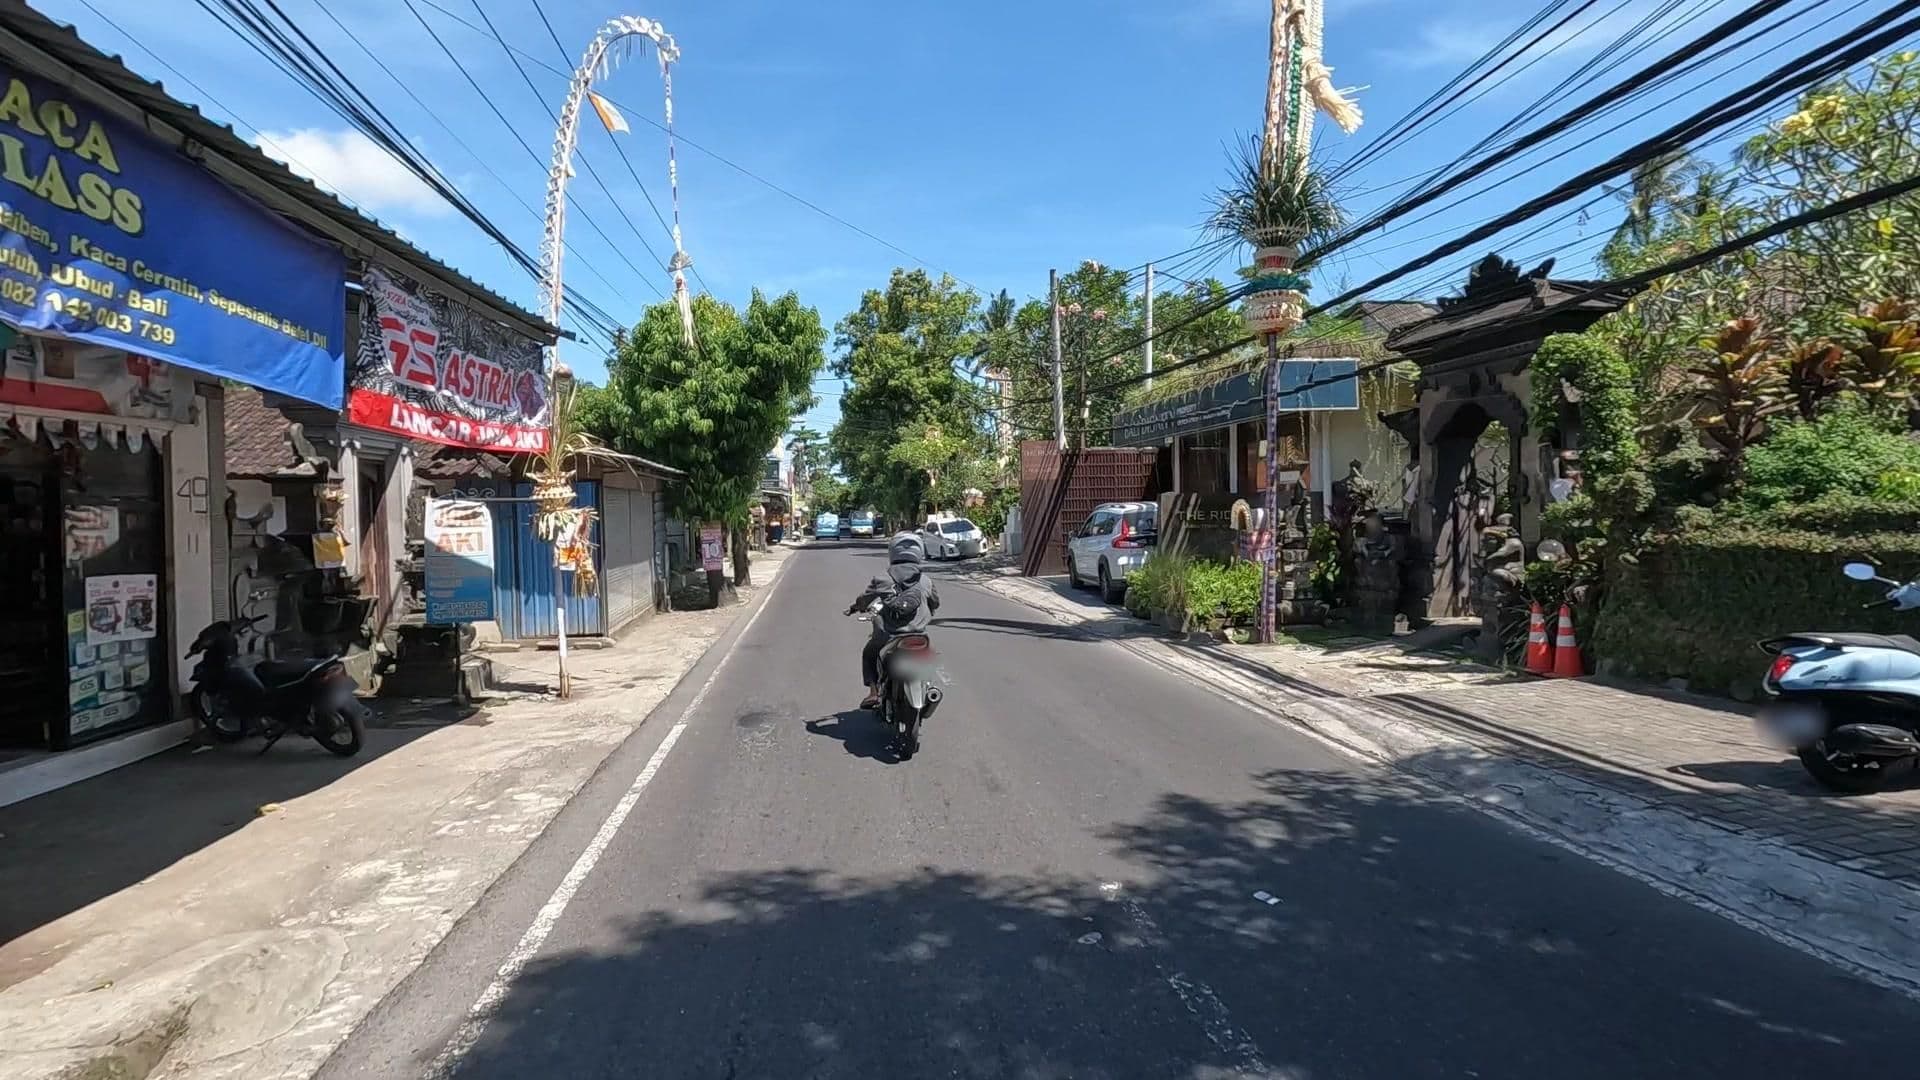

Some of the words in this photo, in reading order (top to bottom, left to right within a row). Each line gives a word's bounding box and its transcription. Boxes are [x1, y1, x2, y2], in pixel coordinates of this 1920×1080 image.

[0, 133, 143, 235] LASS
[51, 263, 114, 300] Ubud
[128, 289, 169, 317] Bali
[70, 234, 127, 272] Kaca
[132, 260, 204, 304] Cermin,
[139, 319, 175, 345] 739
[444, 351, 513, 406] ASTRA
[176, 476, 208, 513] 49
